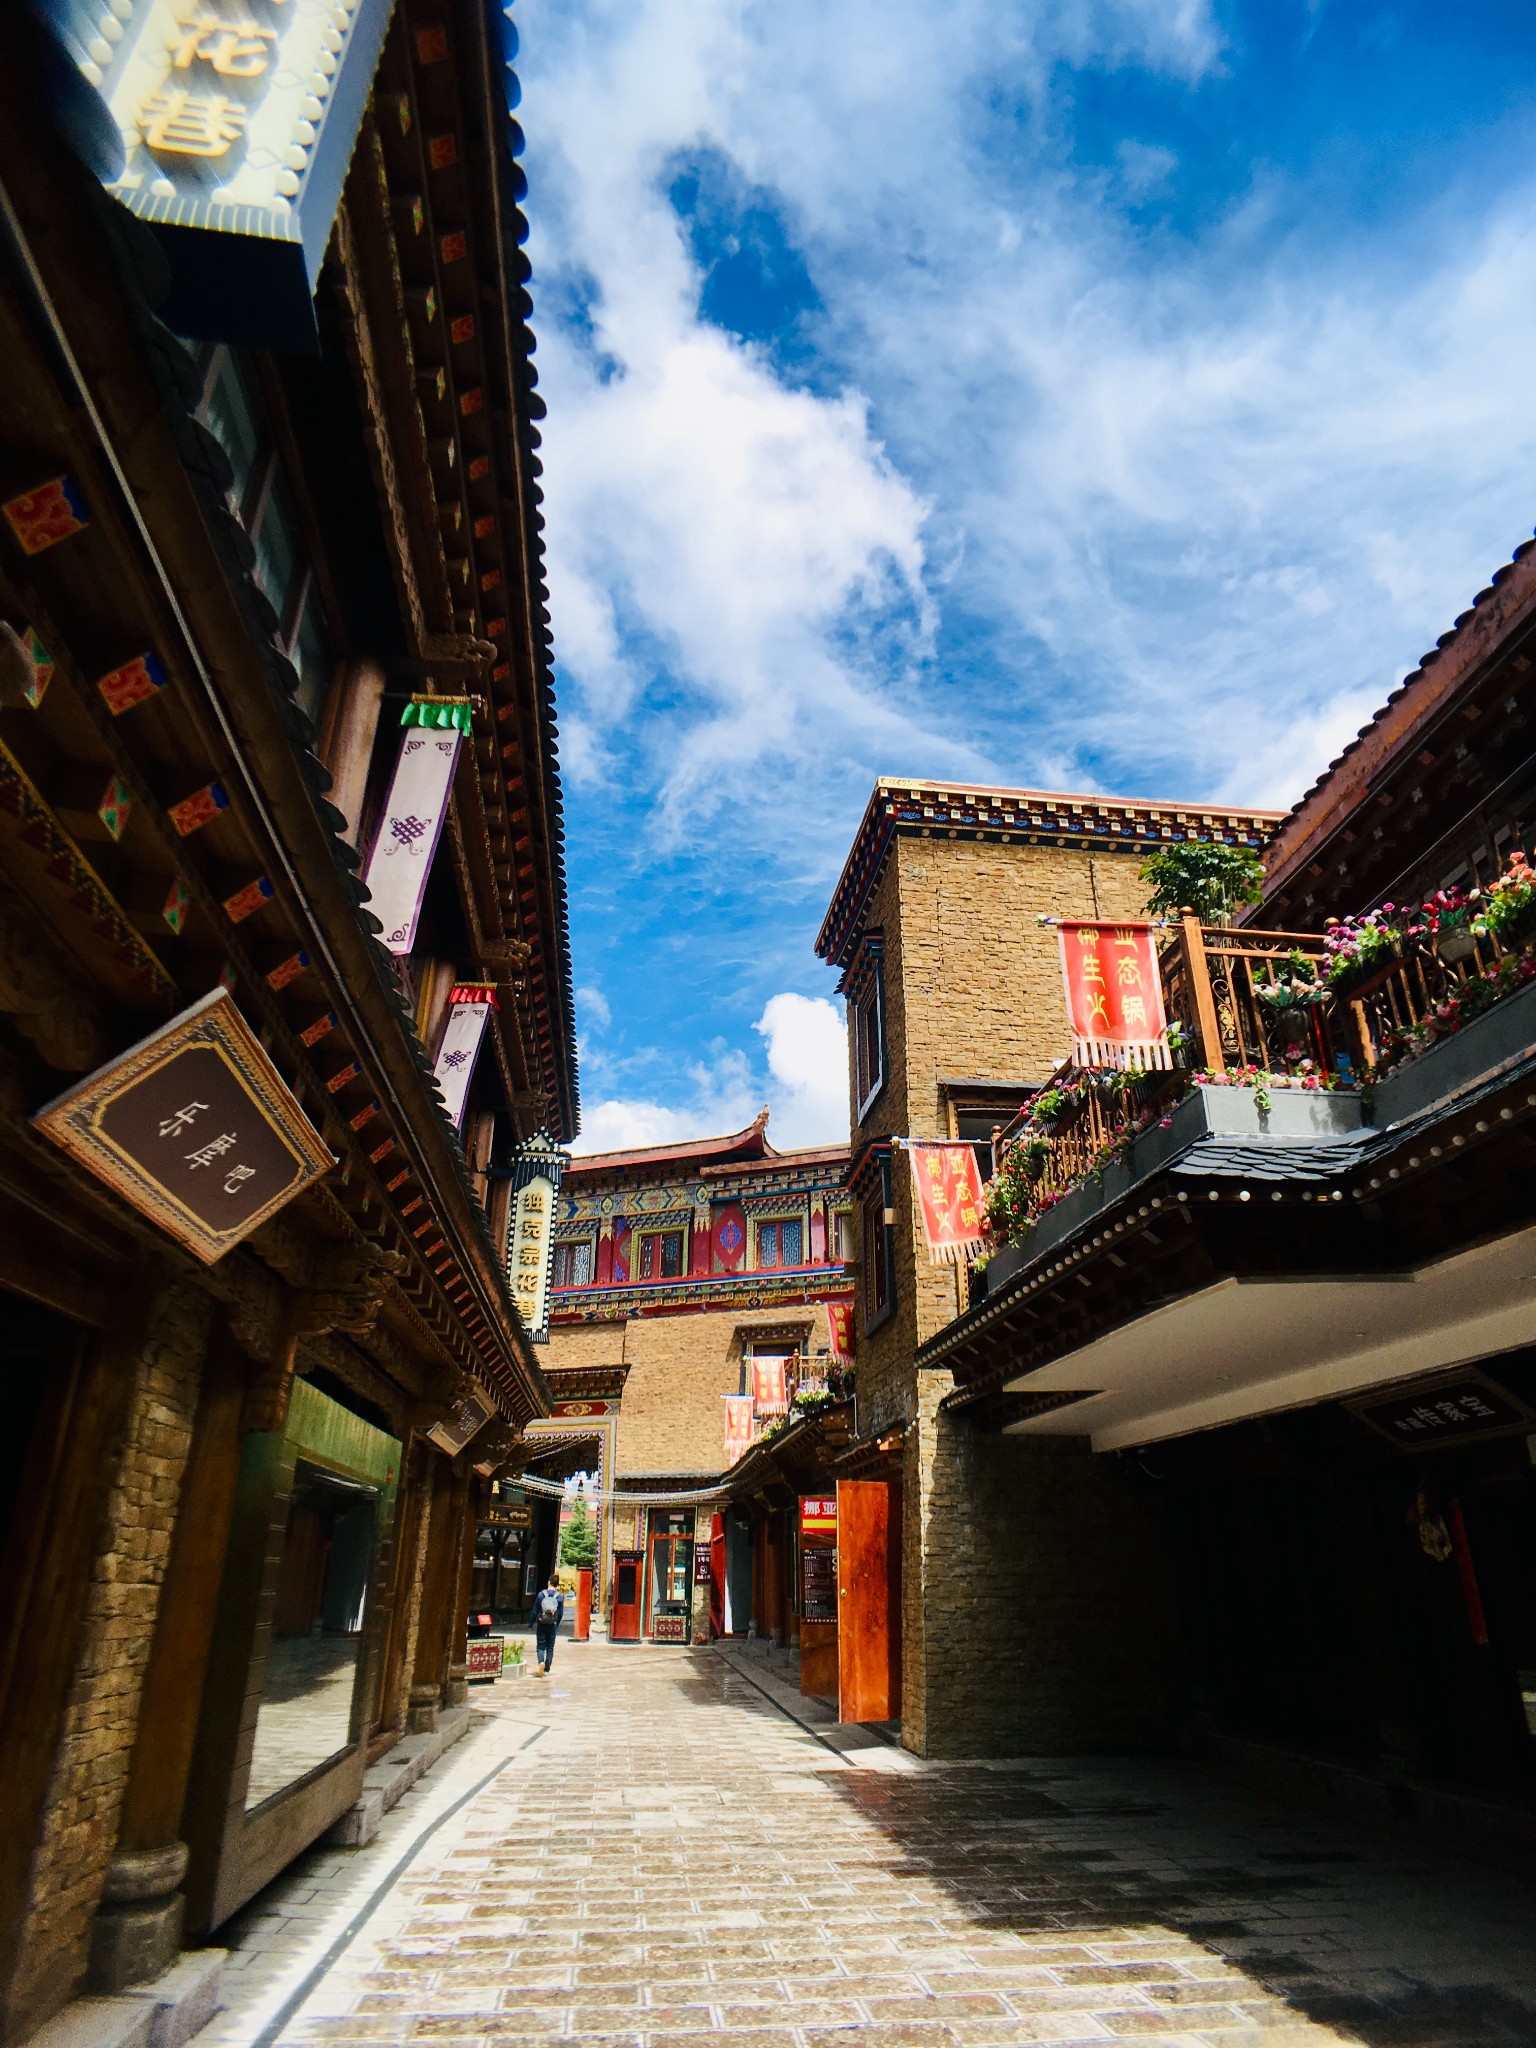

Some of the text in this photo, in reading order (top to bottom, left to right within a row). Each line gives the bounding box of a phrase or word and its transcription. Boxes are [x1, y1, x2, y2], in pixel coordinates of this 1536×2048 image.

[135, 0, 287, 158] 花巷
[159, 1100, 257, 1194] 乐摩吧
[516, 1190, 545, 1320] 独克宗花巷
[804, 1499, 837, 1516] 挪亚
